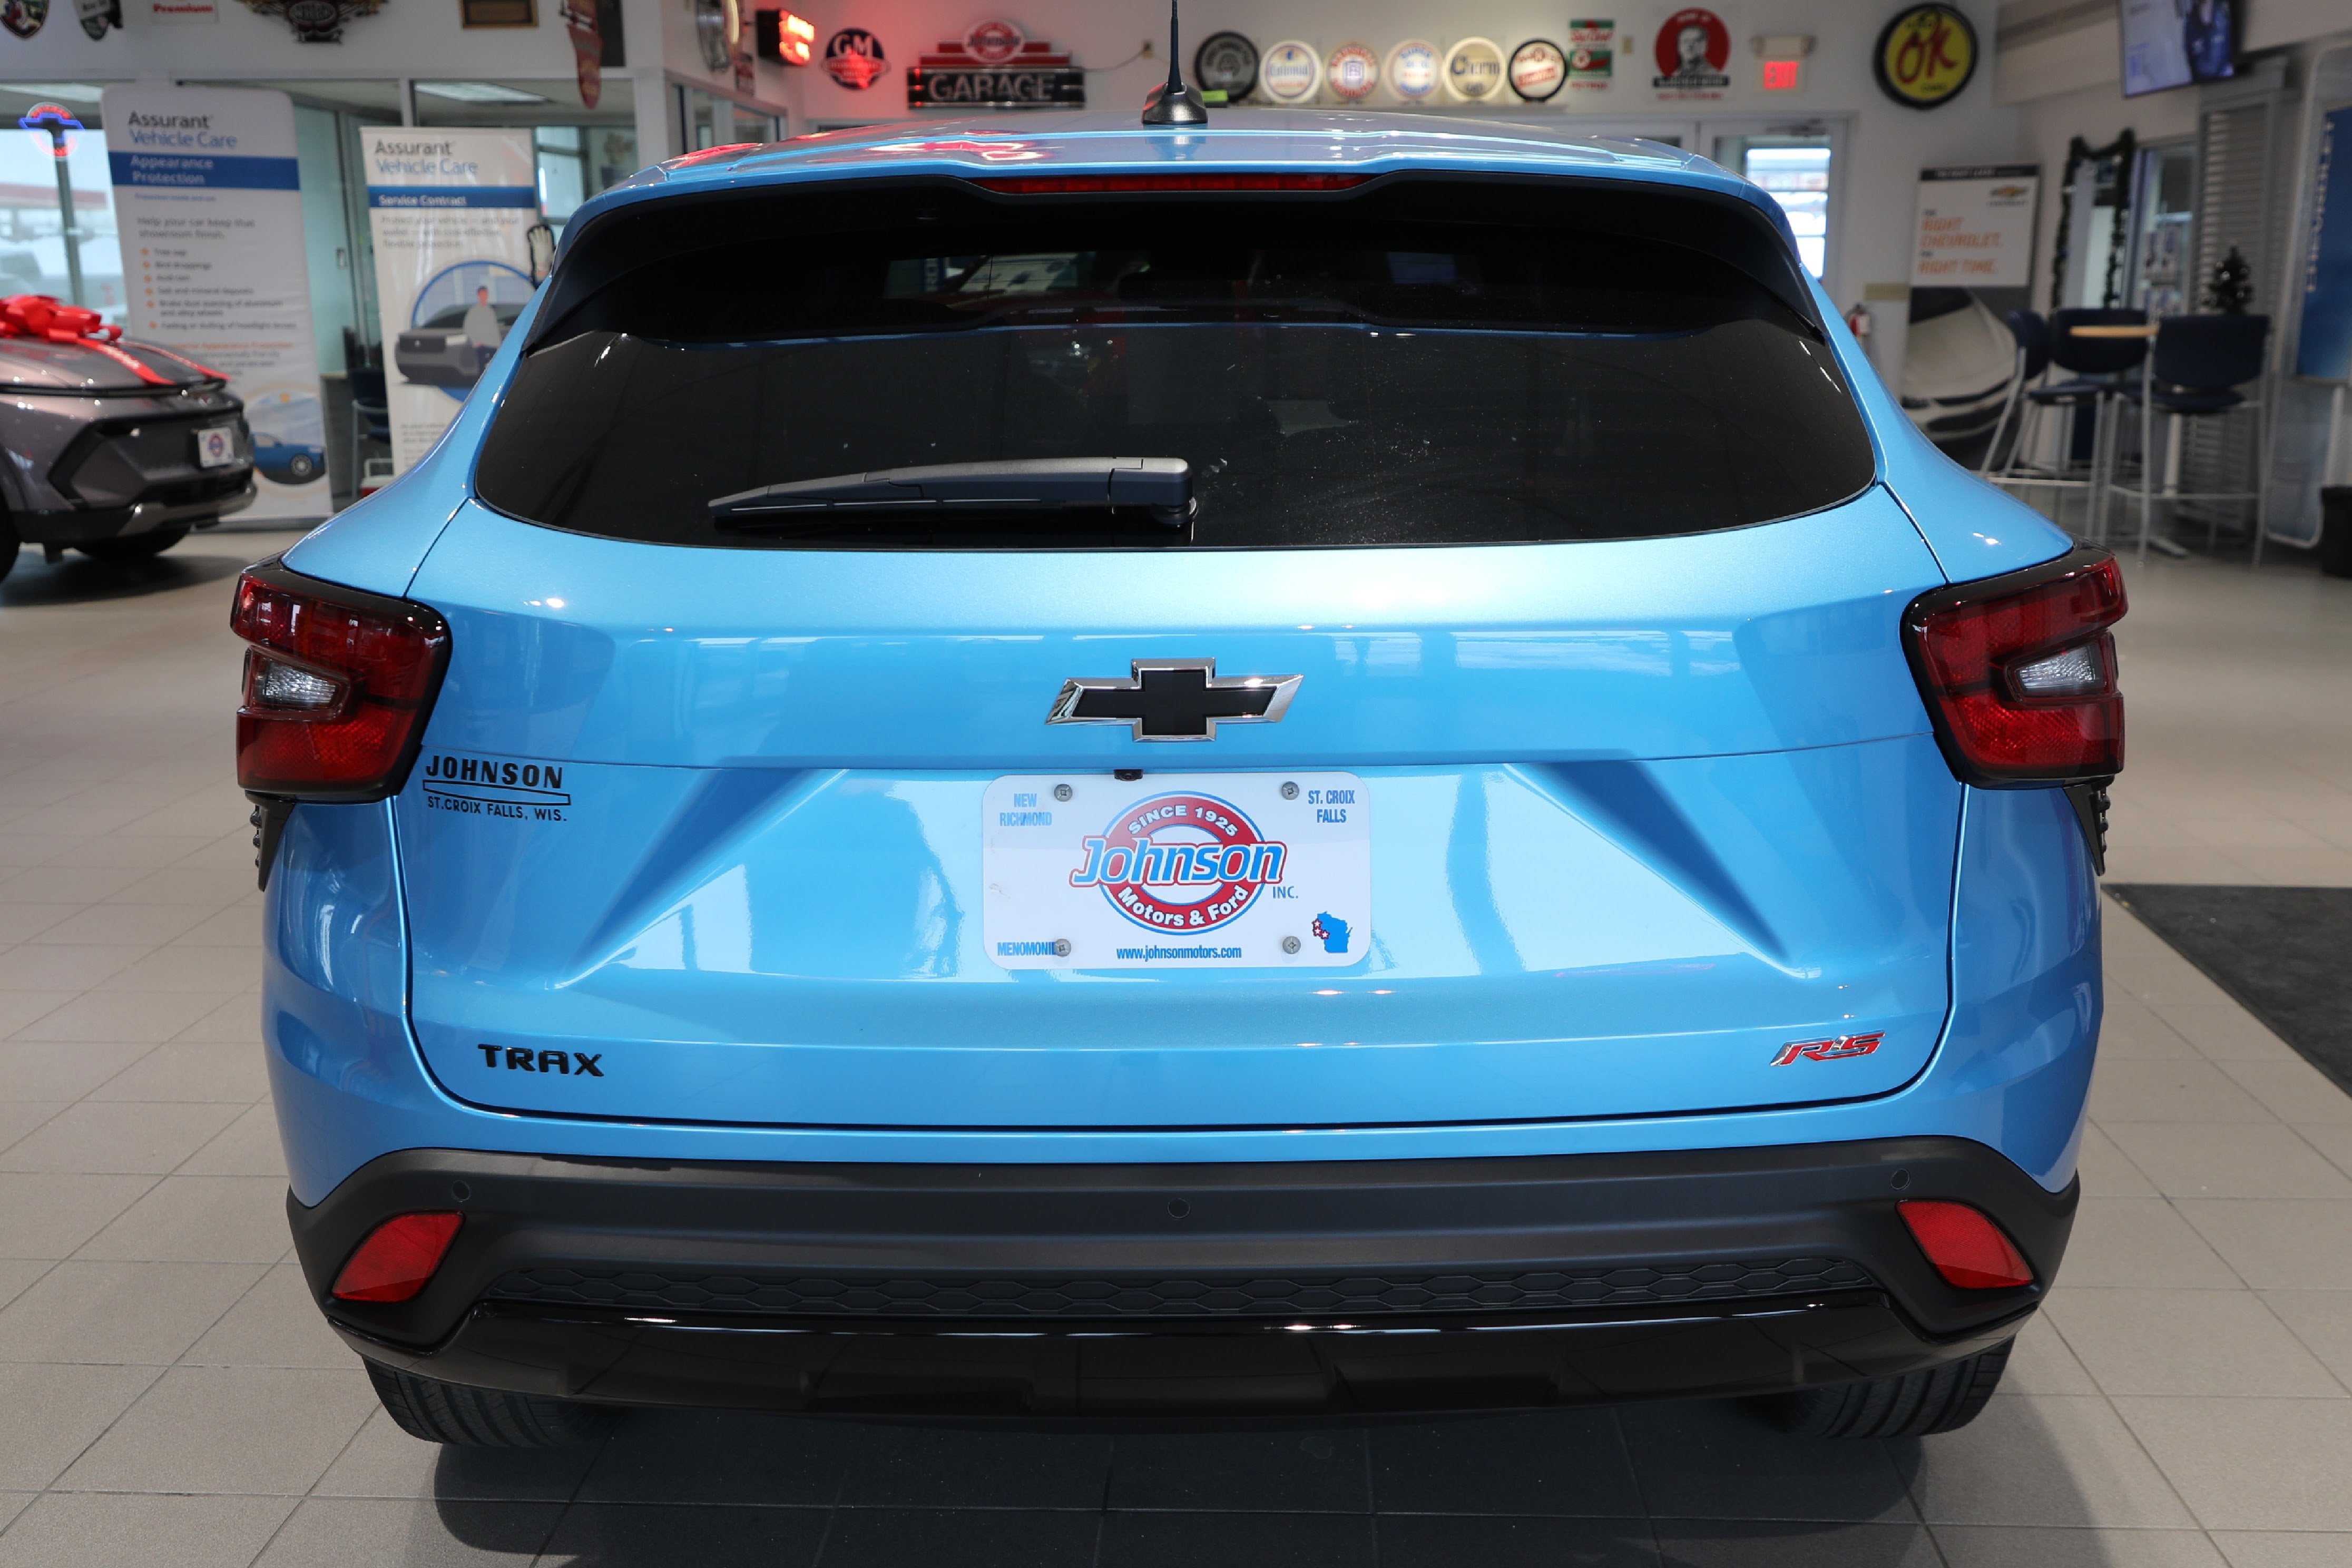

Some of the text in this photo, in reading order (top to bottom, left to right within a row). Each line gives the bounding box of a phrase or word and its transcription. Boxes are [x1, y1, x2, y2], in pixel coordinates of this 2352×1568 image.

[833, 33, 873, 58] GM
[1896, 21, 1958, 85] OK
[928, 74, 1053, 101] GARAGE
[128, 110, 210, 129] Assurant
[130, 130, 237, 149] Vehicle Care
[375, 139, 452, 155] Assurant
[131, 154, 213, 170] Appearance
[376, 158, 478, 175] Vehicle Care
[132, 170, 205, 184] Protection
[378, 194, 467, 206] Service Contract
[426, 755, 563, 789] JOHNSON
[1014, 793, 1037, 807] NEW
[1308, 790, 1355, 805] ST. CROIX
[487, 802, 528, 820] FALLS,
[534, 807, 567, 822] WIS.
[999, 812, 1052, 827] RICHMOND
[1128, 805, 1239, 837] SINCE 1925
[1317, 808, 1347, 823] FALLS
[1071, 837, 1285, 885] Johnson
[1272, 886, 1299, 899] INC.
[1118, 884, 1249, 927] Motors & Ford
[1116, 944, 1242, 962] www.johnsonmotors.com
[1769, 1030, 1886, 1067] RS
[477, 1043, 604, 1077] TRAX
